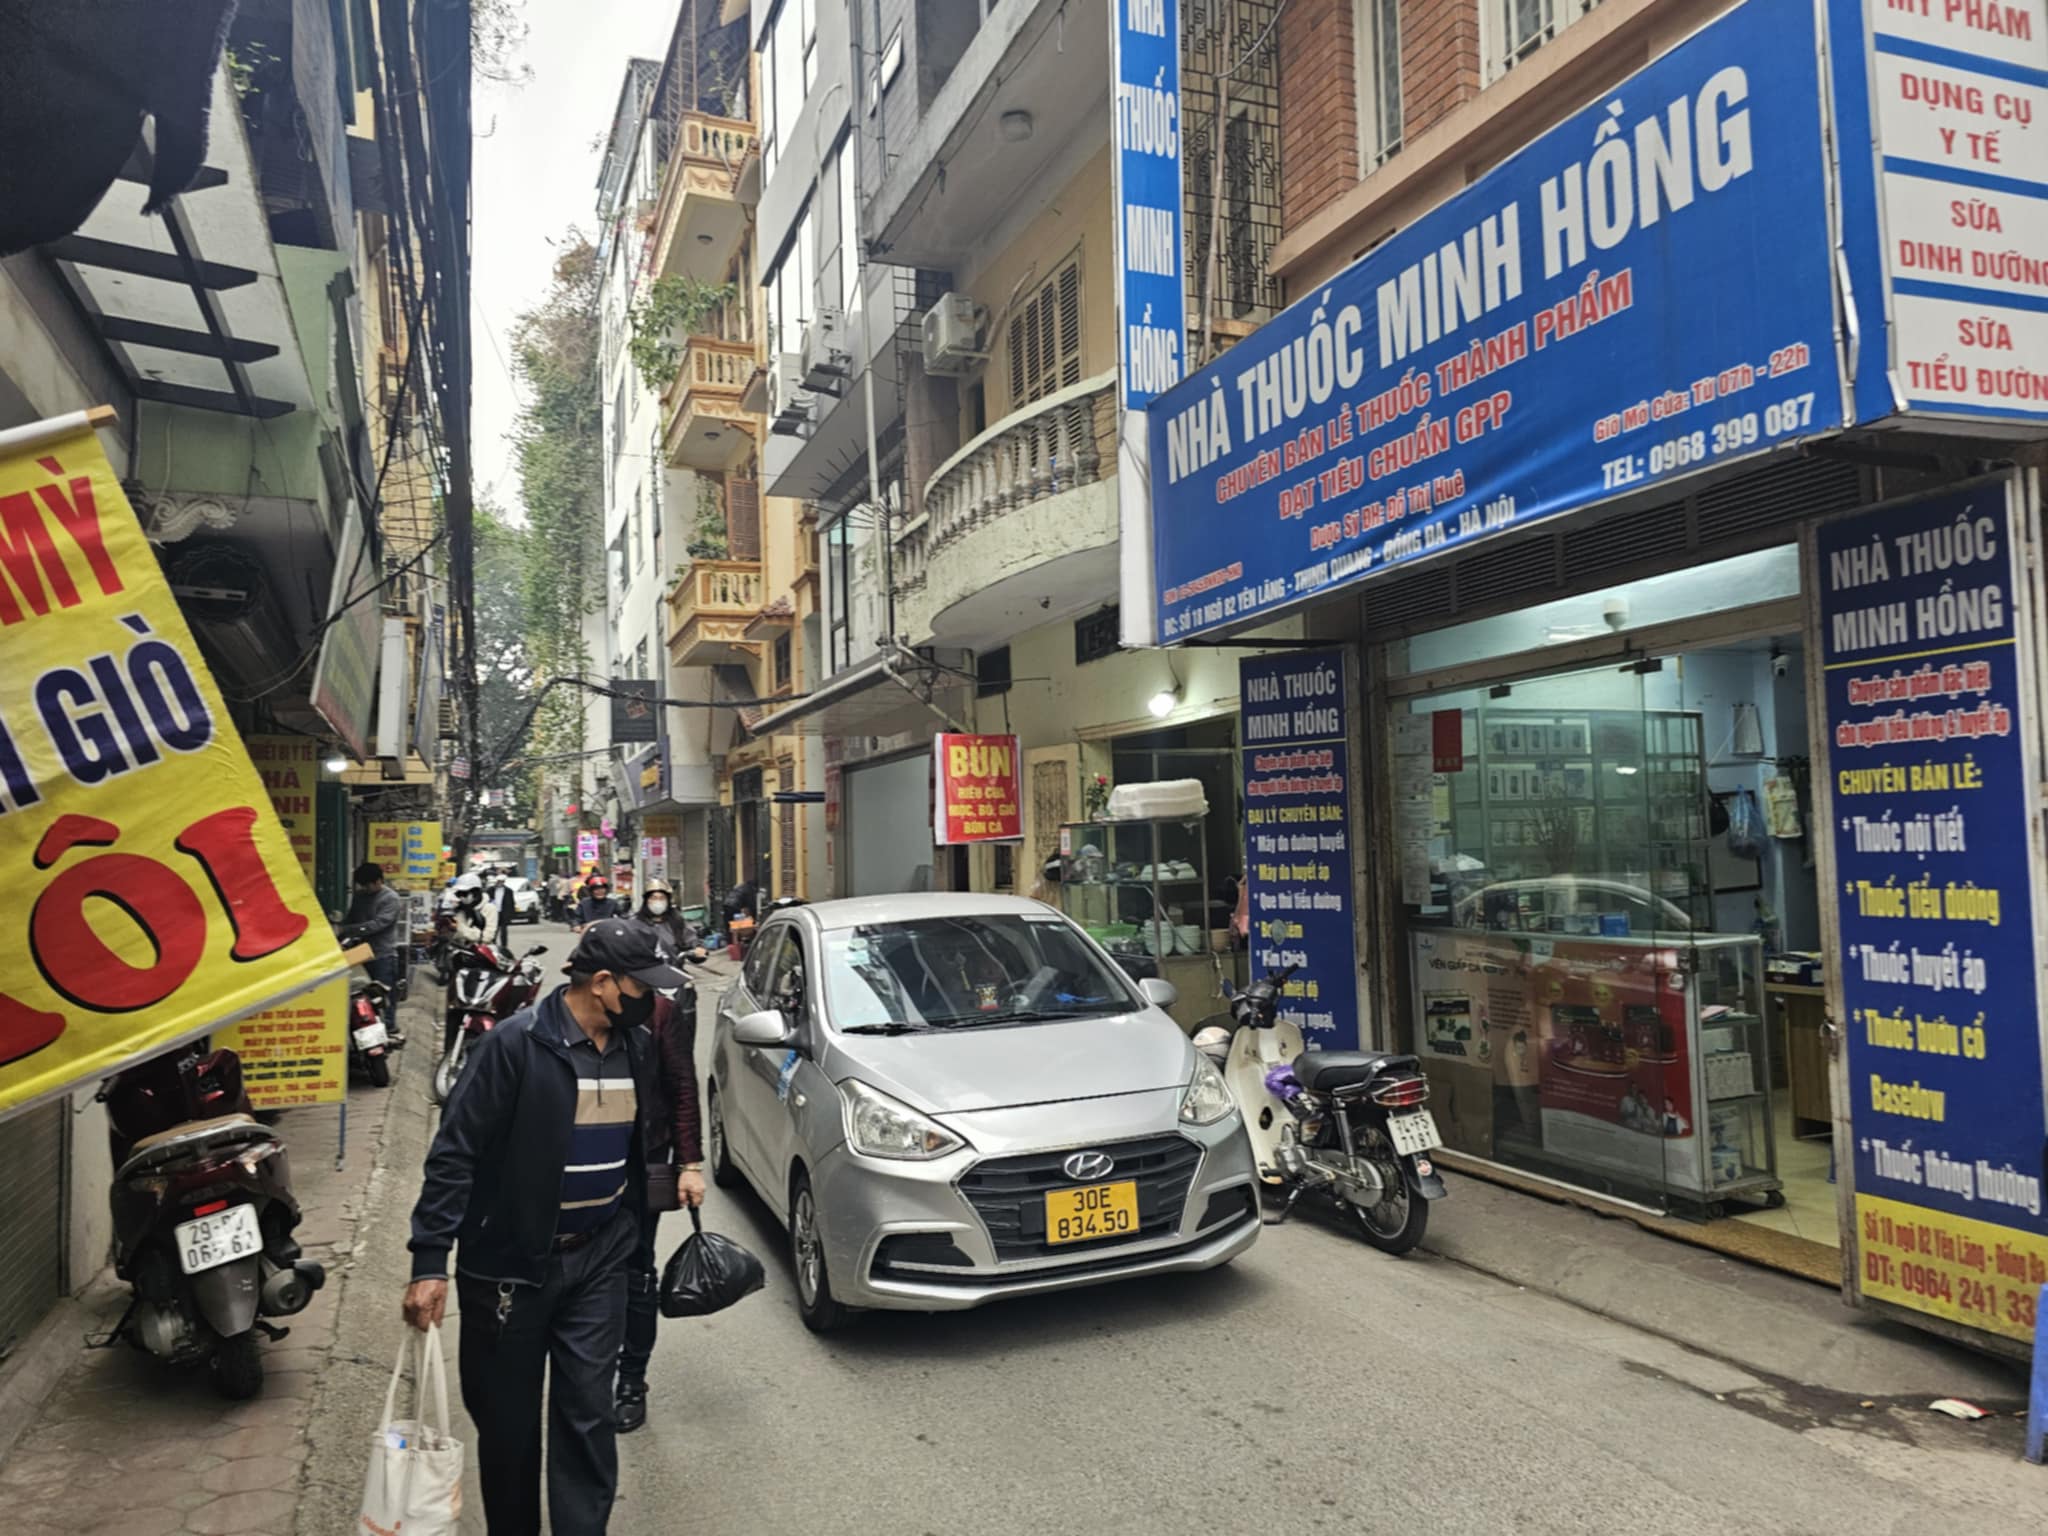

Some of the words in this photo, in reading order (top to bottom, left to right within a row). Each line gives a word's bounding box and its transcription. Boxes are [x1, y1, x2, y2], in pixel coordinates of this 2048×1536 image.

[1120, 66, 1176, 159] THUỐC
[1900, 73, 1983, 115] DỤNG
[1994, 94, 2031, 129] CỤ
[1939, 127, 1956, 154] Y
[1966, 130, 2001, 163] TẾ
[1951, 198, 2002, 233] SỮA
[1126, 205, 1174, 276] MINH
[1899, 240, 1963, 274] DINH
[1167, 376, 1231, 484] NHÀ
[1237, 288, 1364, 443] THUỐC
[1377, 201, 1522, 368] MINH
[1540, 66, 1752, 280] HỒNG
[1958, 316, 2013, 350] SỮA
[1216, 448, 1280, 504] CHUYÊN
[1284, 425, 1324, 471] BÁN
[1356, 369, 1432, 436] THUỐC
[1436, 321, 1527, 398] THÀNH
[1534, 268, 1633, 351] PHẨM
[1717, 363, 1754, 397] 07h
[1769, 342, 1810, 379] 22h
[1907, 353, 1967, 392] TIỂU
[1279, 478, 1316, 520] ĐẠT
[1319, 455, 1364, 503] TIÊU
[1368, 407, 1451, 482] CHUẨN
[1455, 391, 1511, 450] GPP
[1602, 455, 1645, 490] TEL:
[1650, 431, 1705, 475] 0968
[1712, 413, 1758, 454] 399
[1764, 392, 1815, 437] 087
[1459, 505, 1483, 537] HÀ
[1485, 494, 1516, 528] NỘI
[1830, 533, 1890, 591] NHÀ
[1896, 505, 1996, 577] THUỐC
[1832, 602, 1909, 653] MINH
[34, 613, 215, 787] GIÒ
[1247, 672, 1280, 703] NHÀ
[1284, 661, 1336, 698] THUỐC
[1248, 713, 1290, 740] MINH
[949, 739, 1010, 778] BÚN
[1839, 762, 1906, 795] CHUYÊN
[1910, 759, 1949, 791] BÁN
[1279, 803, 1317, 823] CHUYÊN
[0, 806, 309, 1066] ÔI
[1073, 1187, 1111, 1212] 30E
[1058, 1209, 1129, 1239] 834.50
[1866, 1252, 1895, 1287] ĐT:
[1902, 1262, 1952, 1303] 0964
[1959, 1277, 1997, 1317] 241
